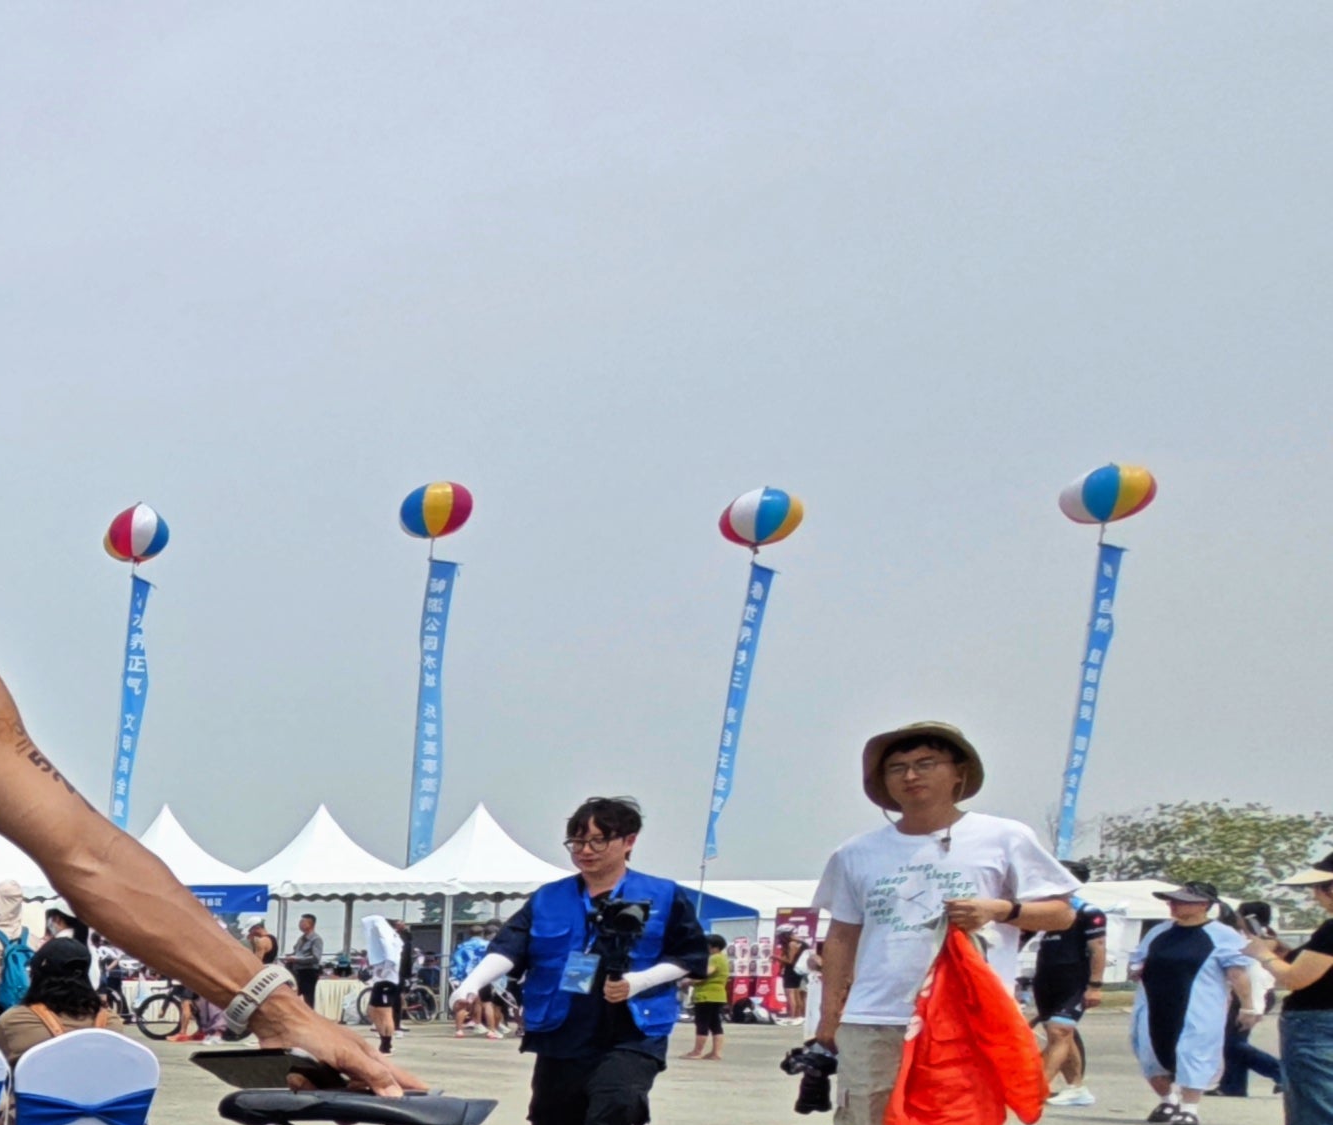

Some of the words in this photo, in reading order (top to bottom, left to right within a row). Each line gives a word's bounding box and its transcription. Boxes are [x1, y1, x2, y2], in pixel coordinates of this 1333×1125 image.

[899, 864, 933, 874] sleep
[926, 869, 961, 880] sleep
[876, 875, 908, 886] sleep
[938, 880, 974, 890] sleep
